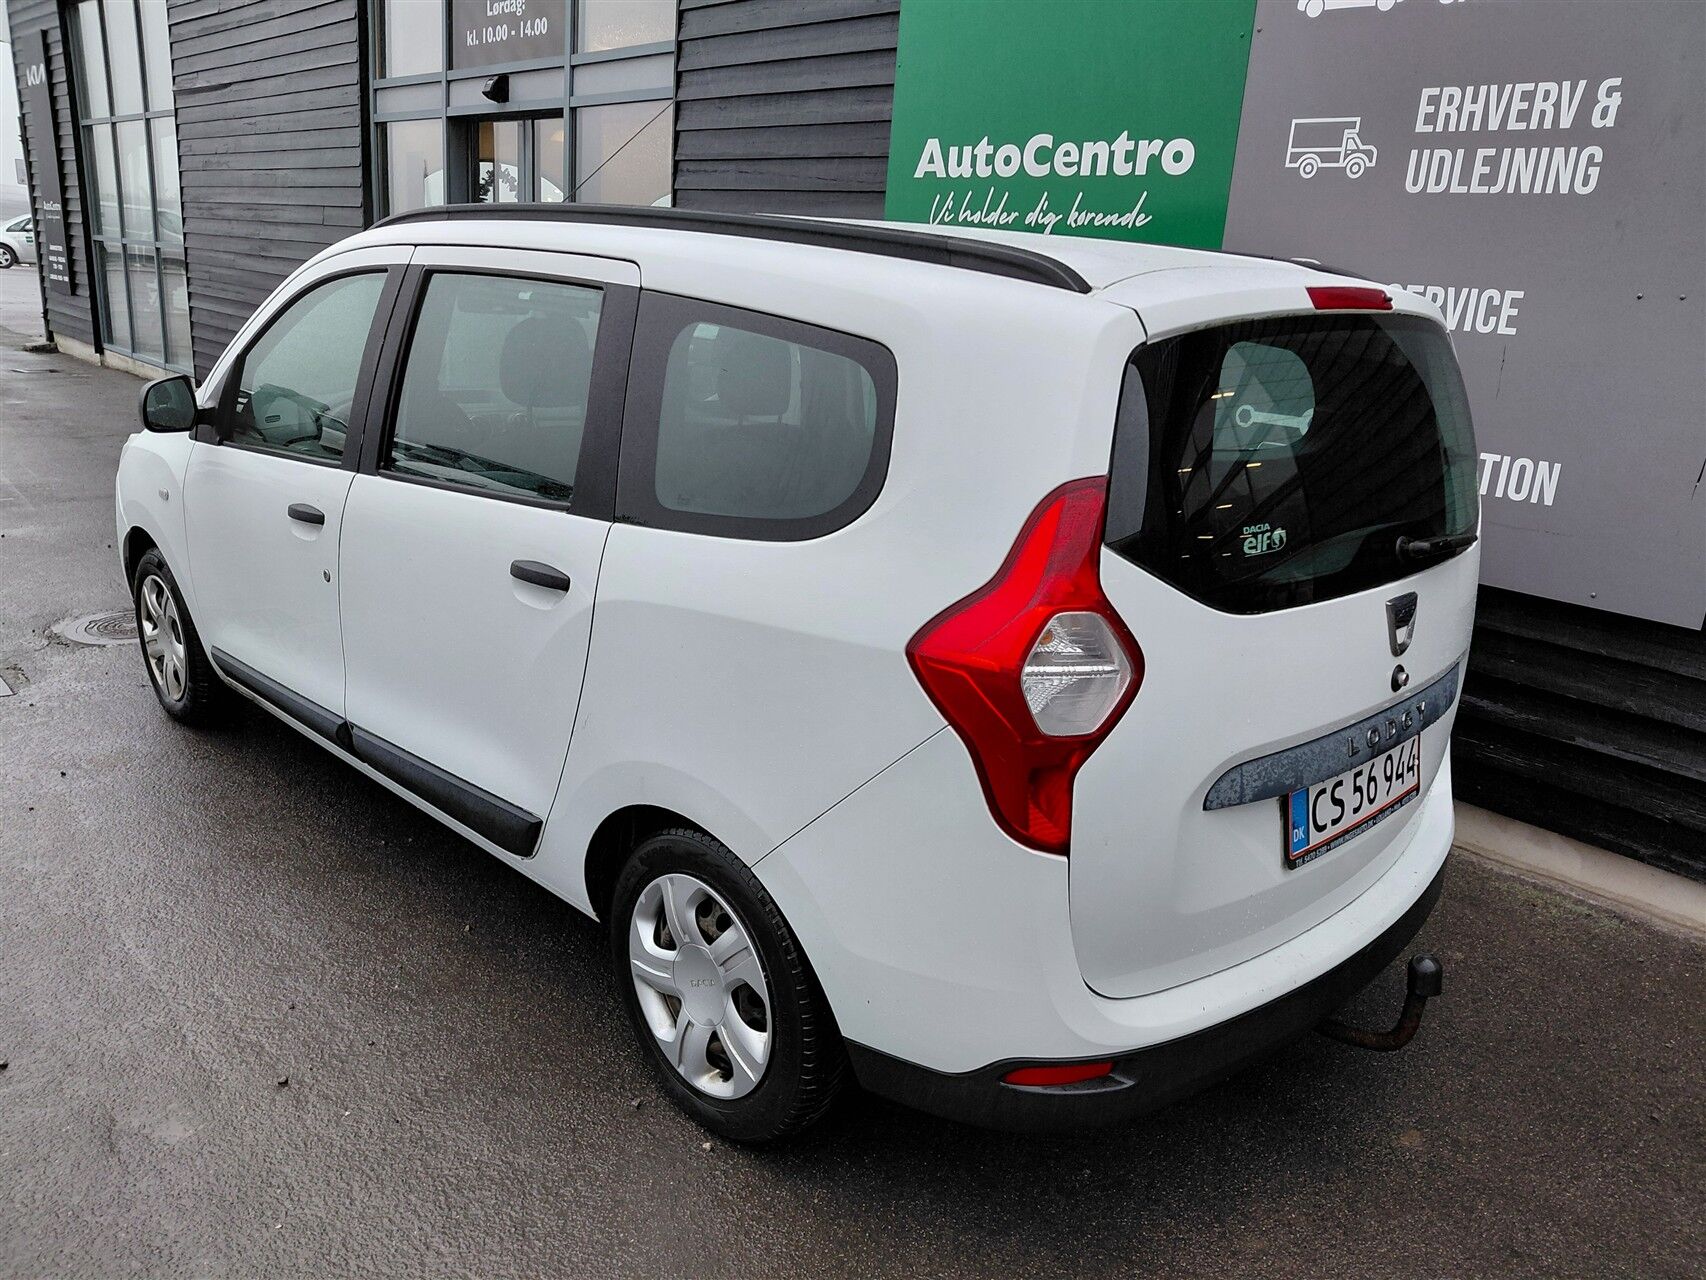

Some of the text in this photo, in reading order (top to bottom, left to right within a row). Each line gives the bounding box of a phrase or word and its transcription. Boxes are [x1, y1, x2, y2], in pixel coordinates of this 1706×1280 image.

[466, 29, 479, 47] kl.
[482, 23, 508, 44] 10.00
[520, 16, 548, 38] 14.00
[486, 0, 525, 16] Lørdag:
[1415, 77, 1623, 133] ERHVERV &
[913, 130, 1195, 178] AutoCentro
[1405, 145, 1604, 195] UDLEJNING
[929, 186, 1152, 235] Vi holder dig kørende
[1243, 523, 1270, 534] DACIA
[1243, 532, 1271, 553] elf
[1347, 700, 1425, 757] LODGY
[1311, 738, 1416, 833] CS 56 944
[1293, 826, 1305, 842] DK
